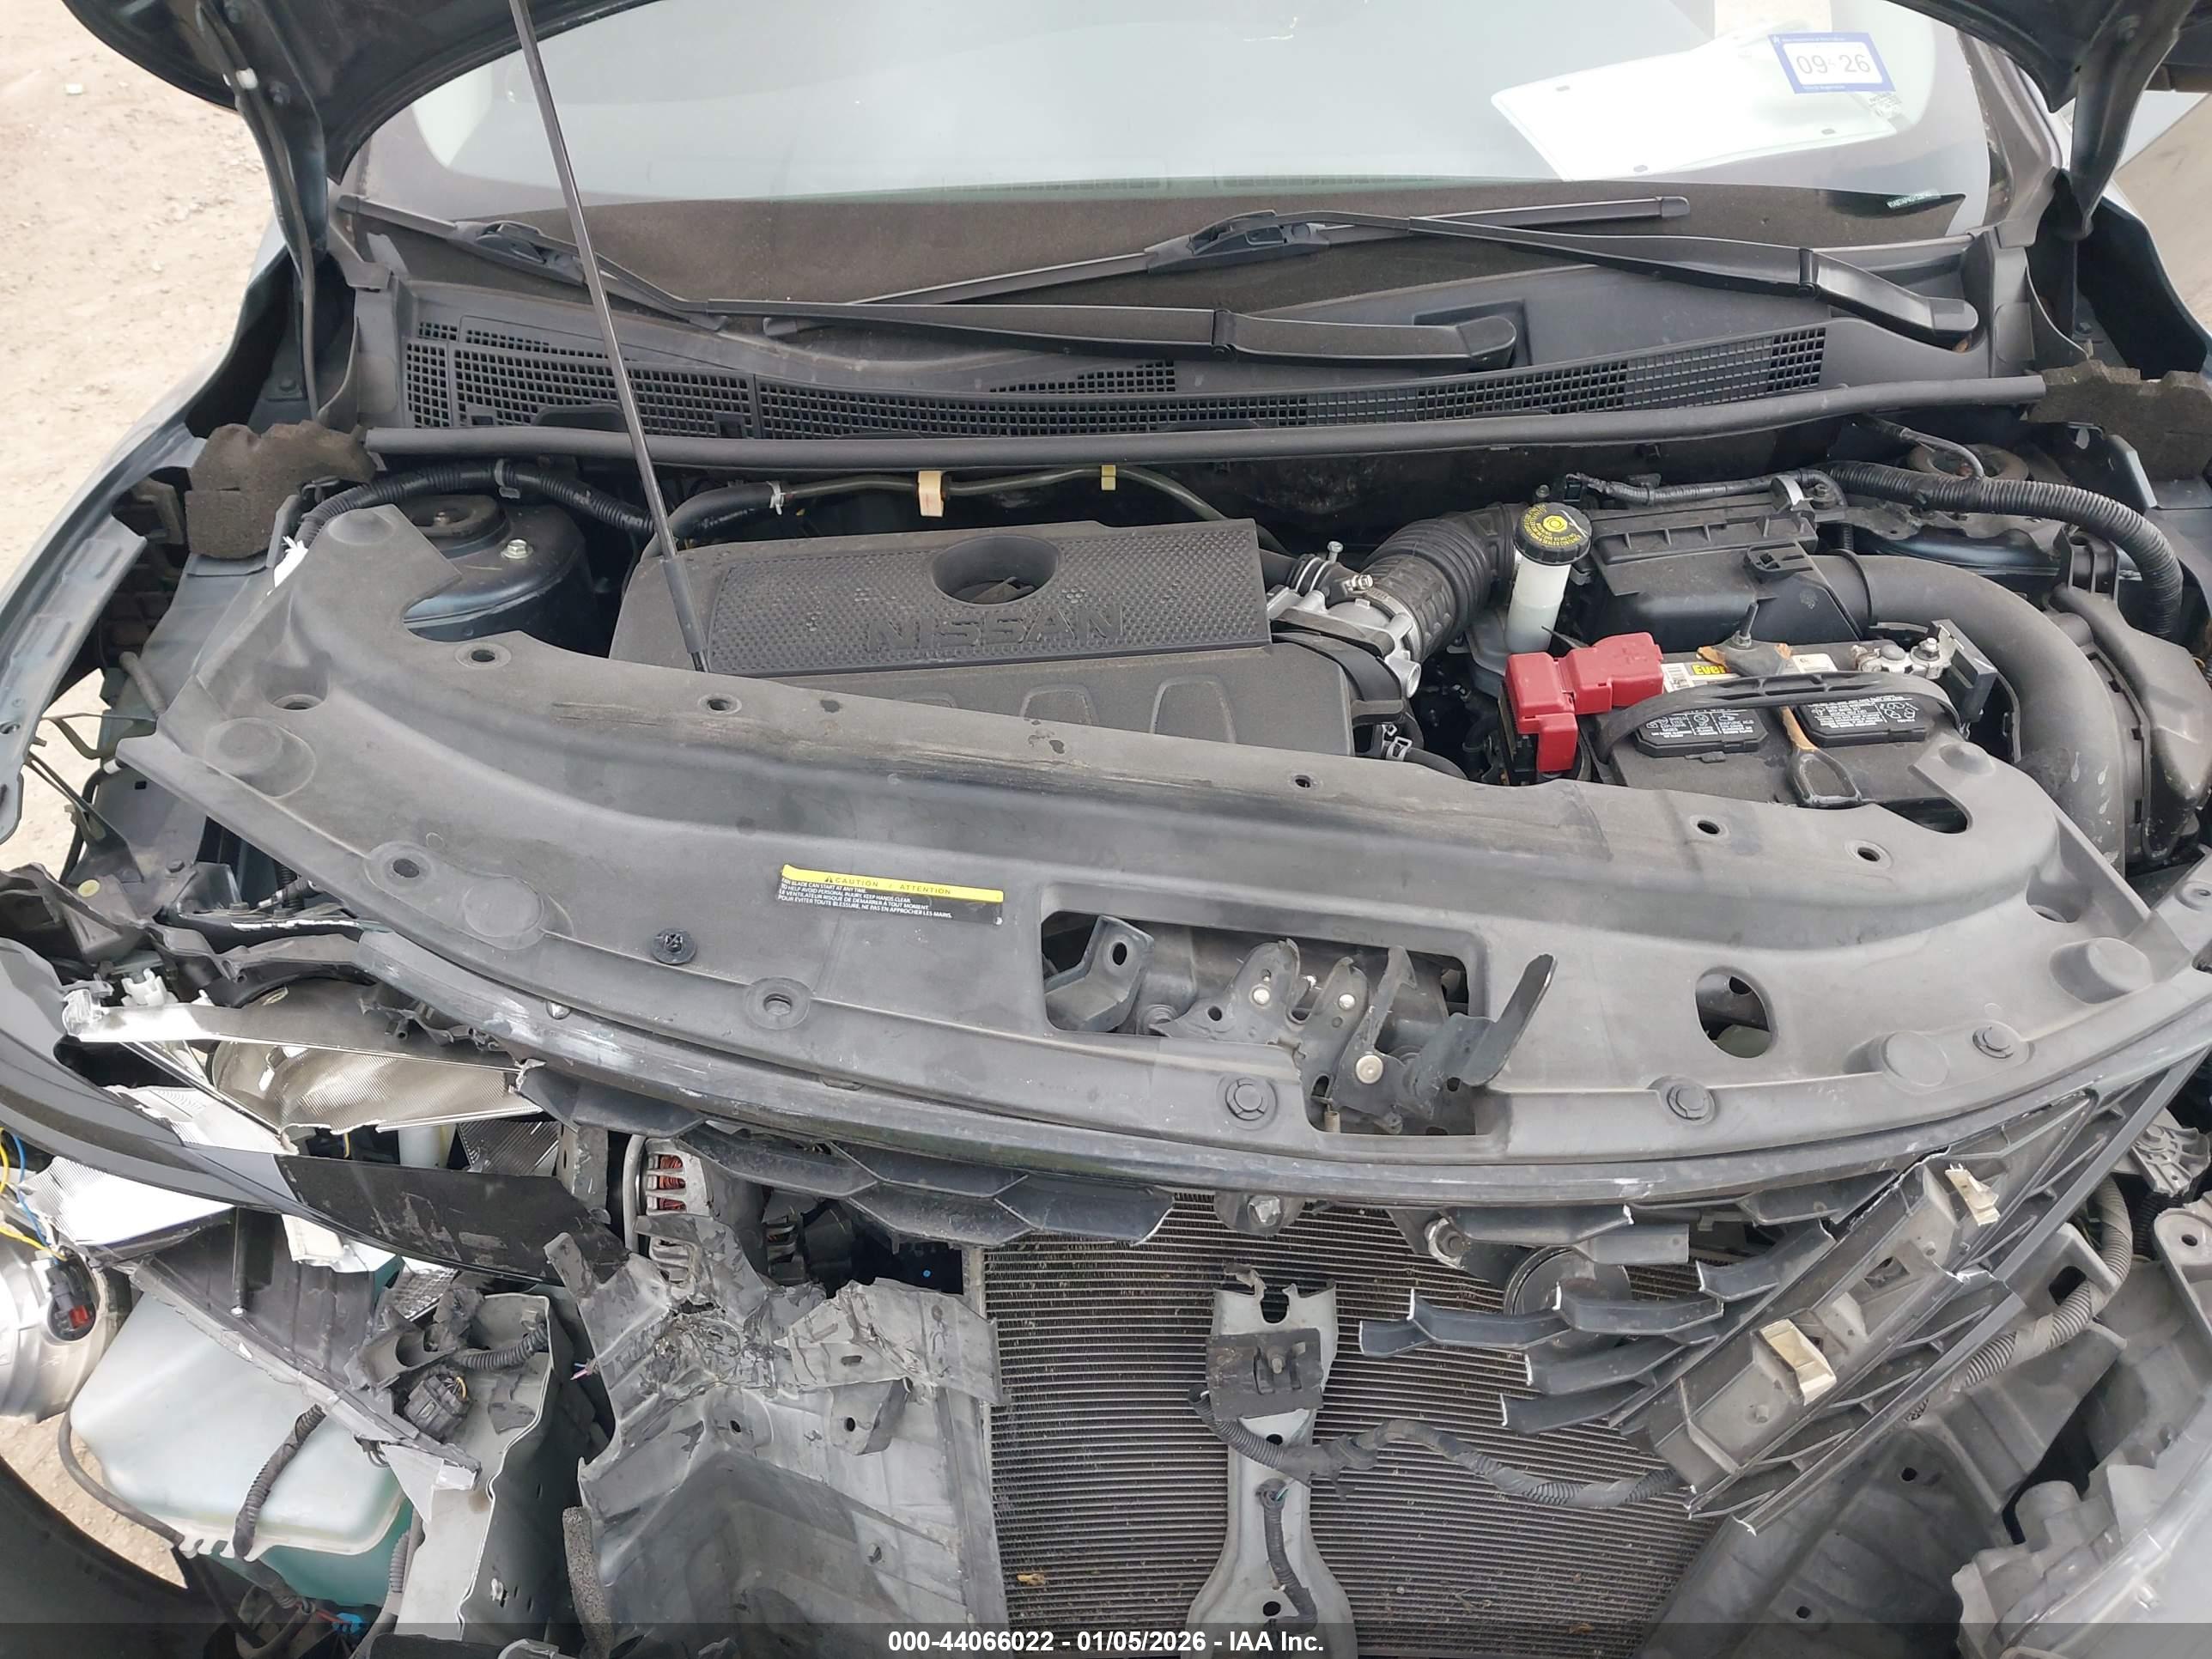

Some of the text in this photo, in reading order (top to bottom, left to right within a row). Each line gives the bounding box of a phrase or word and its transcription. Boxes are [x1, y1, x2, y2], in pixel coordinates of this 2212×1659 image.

[1796, 54, 1870, 75] 09 26
[867, 604, 1123, 653] NISSAN
[786, 890, 823, 899] VENTILATEUR
[835, 878, 878, 887] CAUTION
[900, 884, 951, 895] ATTENTION
[890, 907, 922, 915] APPROCHER
